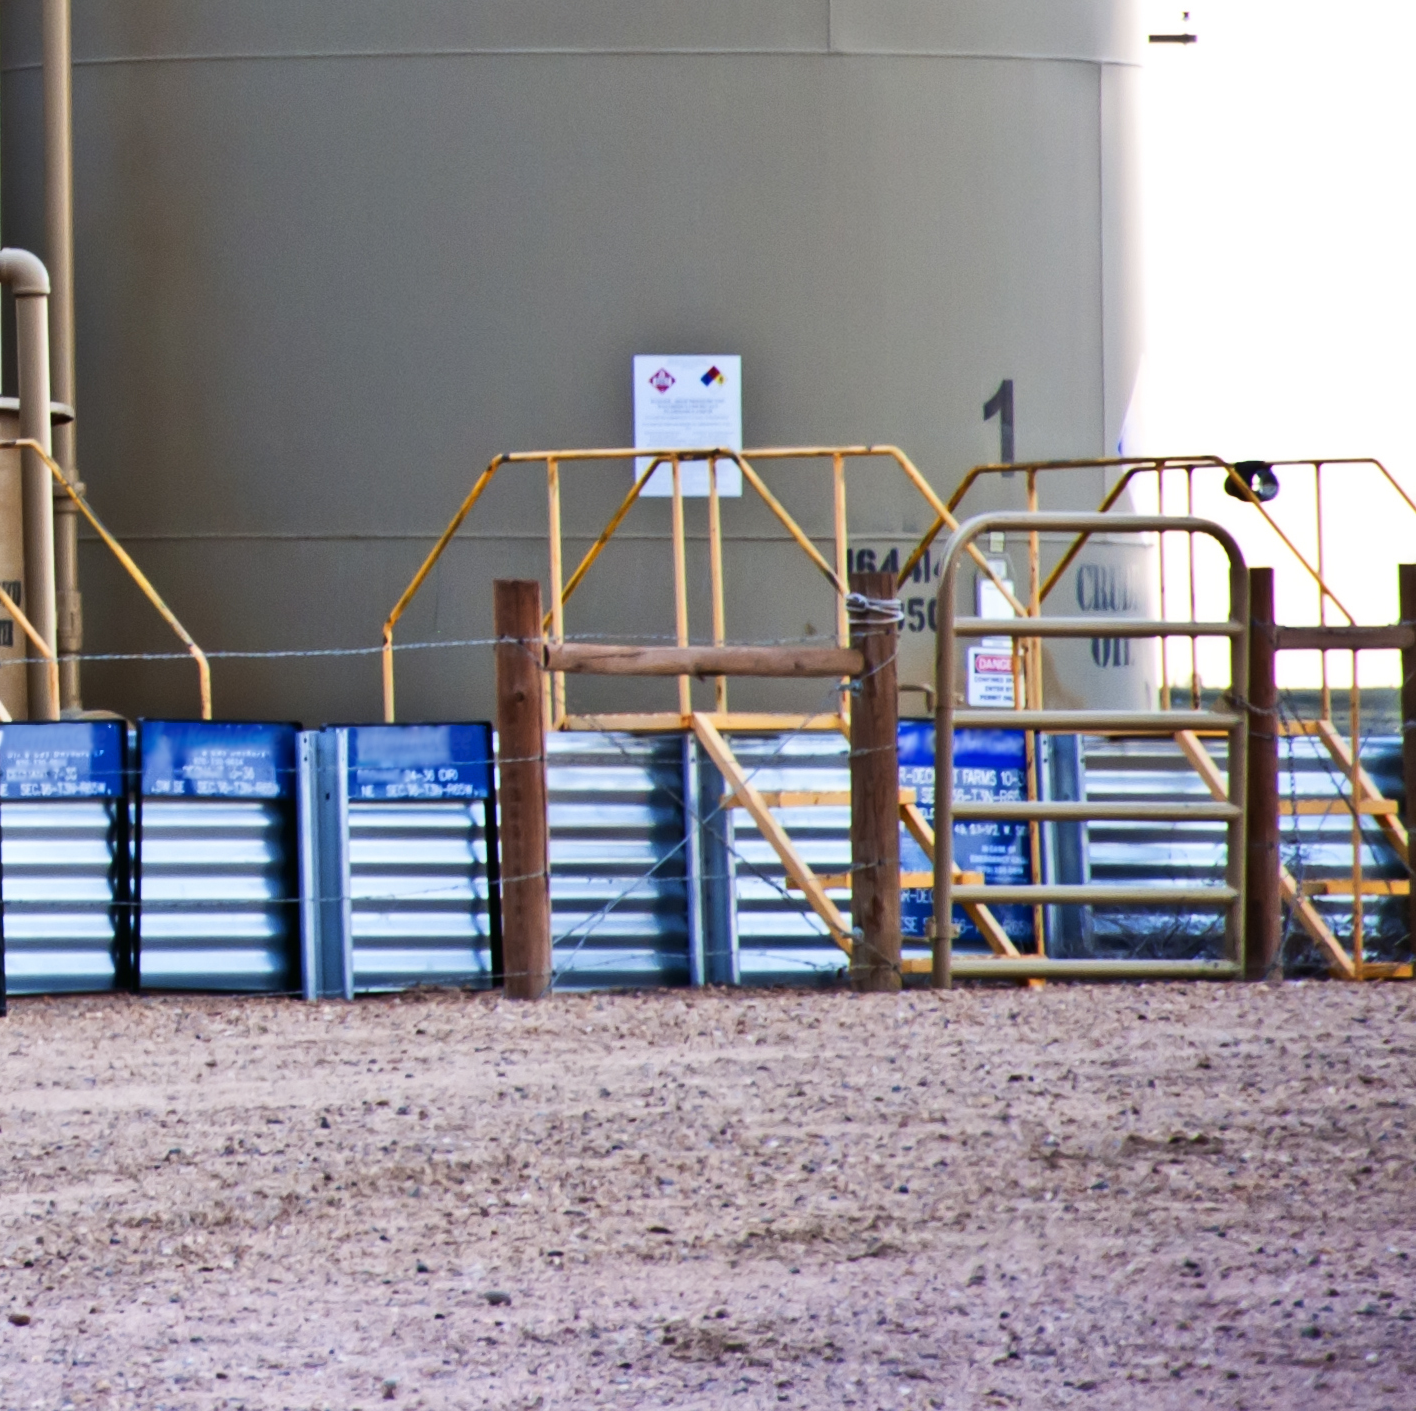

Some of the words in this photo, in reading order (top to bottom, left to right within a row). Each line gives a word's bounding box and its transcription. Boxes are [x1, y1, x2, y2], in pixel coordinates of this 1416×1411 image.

[983, 379, 1015, 477] 1
[979, 658, 1013, 671] DANGE
[963, 768, 997, 786] FARMS
